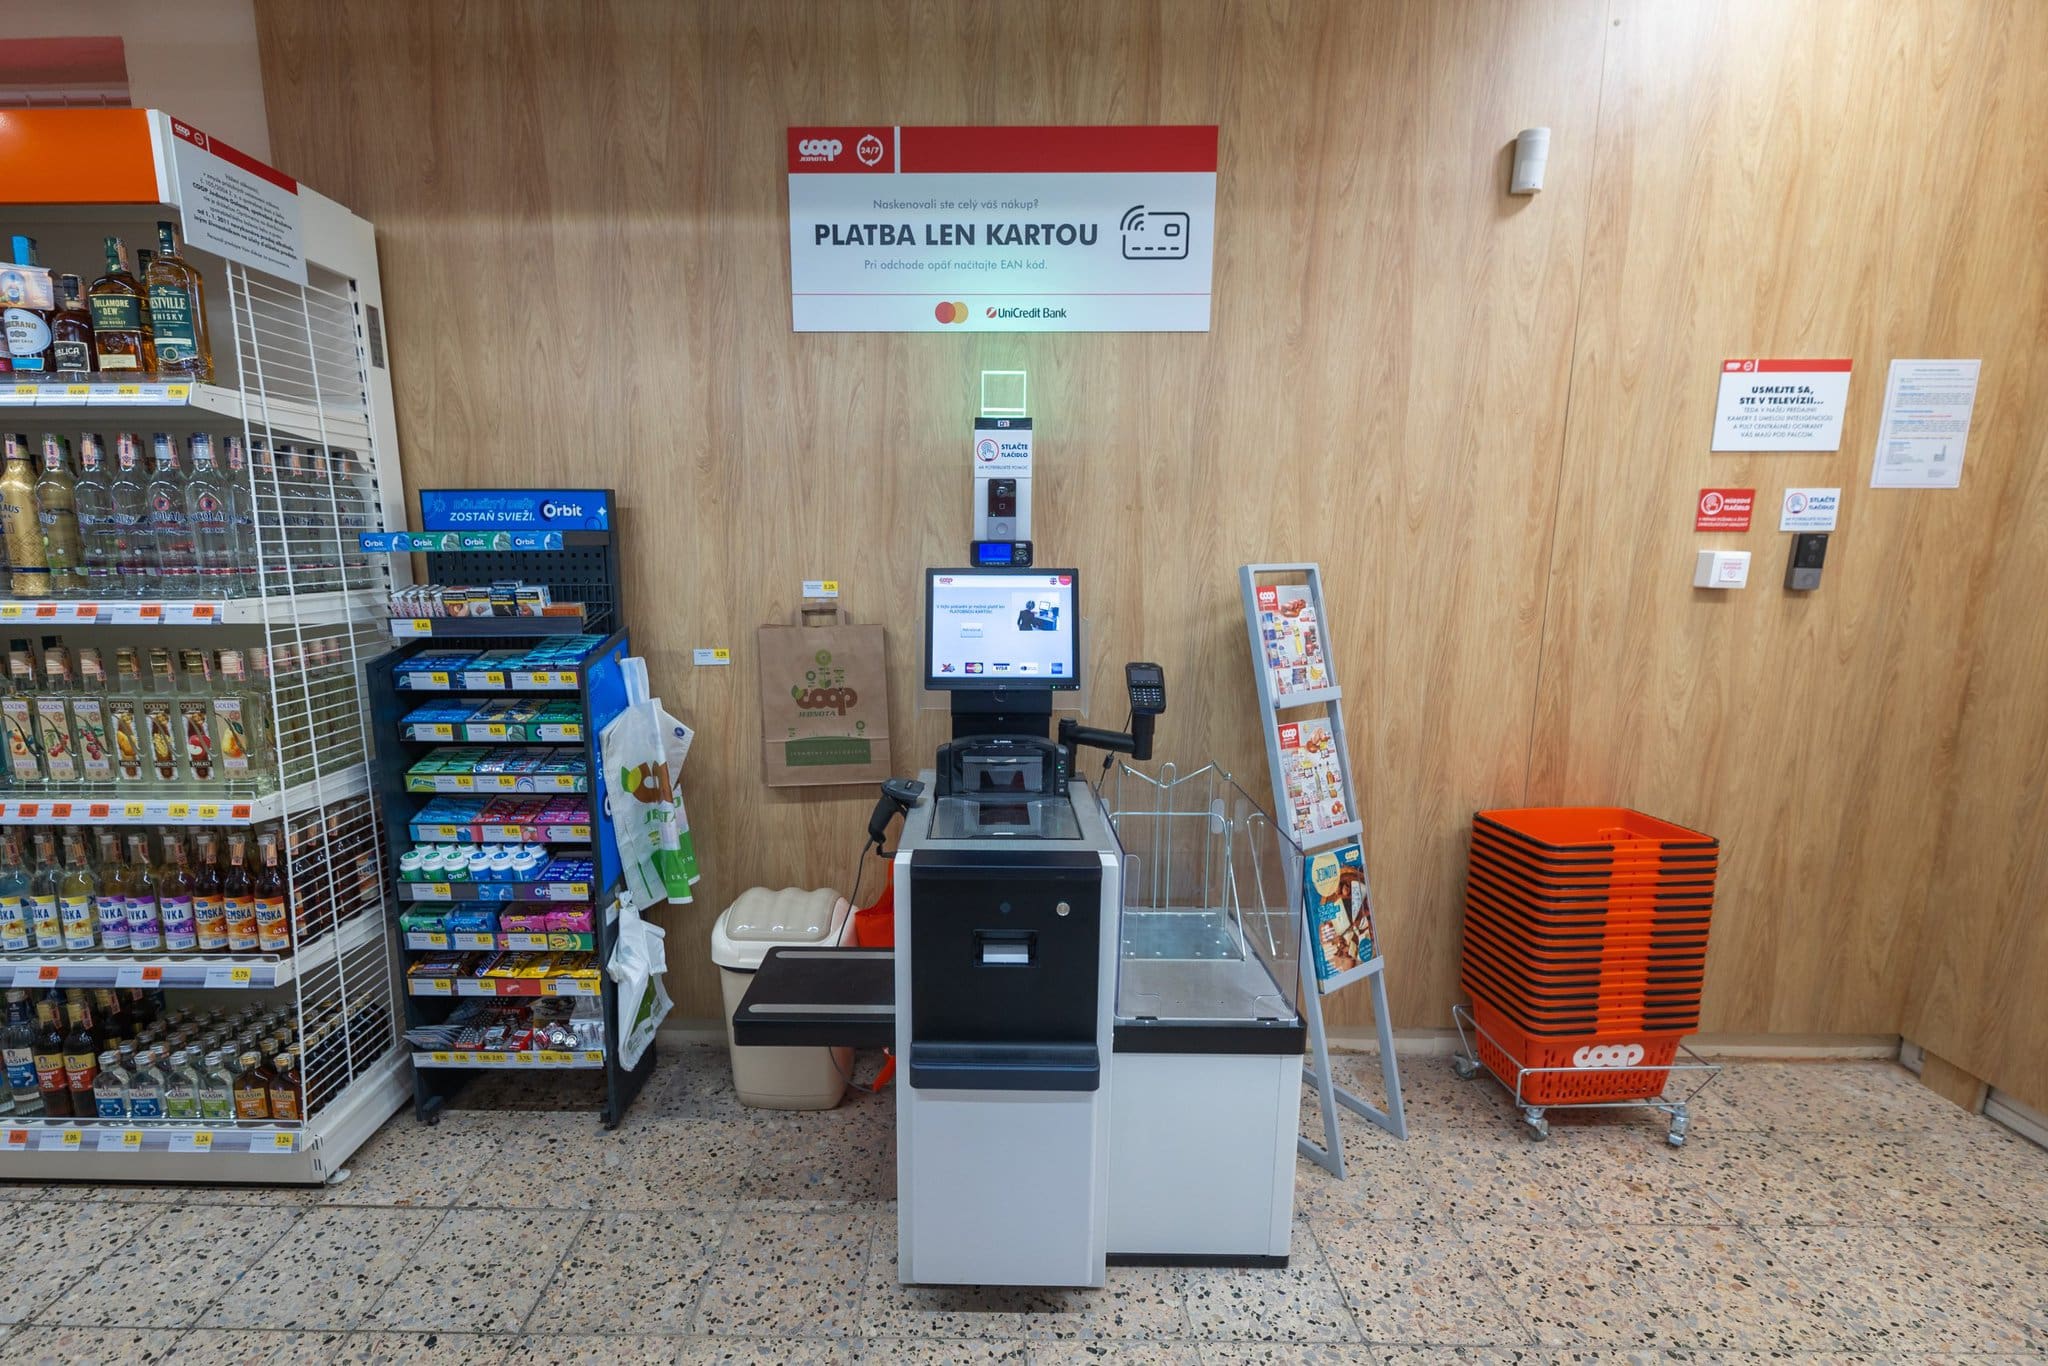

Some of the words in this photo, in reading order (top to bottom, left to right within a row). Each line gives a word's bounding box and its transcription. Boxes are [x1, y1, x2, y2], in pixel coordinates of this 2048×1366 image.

[799, 139, 843, 161] coop
[873, 199, 937, 209] Naskenovali
[940, 200, 955, 209] ste
[958, 199, 977, 211] celý
[980, 199, 998, 209] váš
[1001, 198, 1039, 211] nákup?
[815, 223, 916, 246] PLATBA
[925, 223, 975, 246] LEN
[986, 223, 1098, 246] KARTOU
[864, 259, 877, 270] Pri
[880, 259, 924, 270] odchode
[954, 259, 998, 272] načítajte
[1000, 260, 1023, 270] EAN
[1026, 259, 1048, 270] kód.
[998, 307, 1040, 319] UniCredit
[1042, 307, 1067, 319] Bank
[1752, 386, 1795, 394] USMEJTE
[1797, 386, 1814, 395] SA,
[1739, 397, 1755, 405] STE
[1759, 397, 1766, 405] V
[1001, 442, 1028, 450] STLAČTE
[450, 510, 495, 521] ZOSTAŇ
[497, 510, 535, 521] SVIEŽI.
[543, 502, 583, 518] Orbit
[364, 539, 384, 547] Orbit
[413, 538, 432, 547] Orbit
[464, 538, 485, 546] Orbit
[515, 537, 535, 546] Orbit
[792, 686, 858, 716] coop
[447, 871, 467, 880] Orbit
[1572, 1043, 1645, 1068] coop
